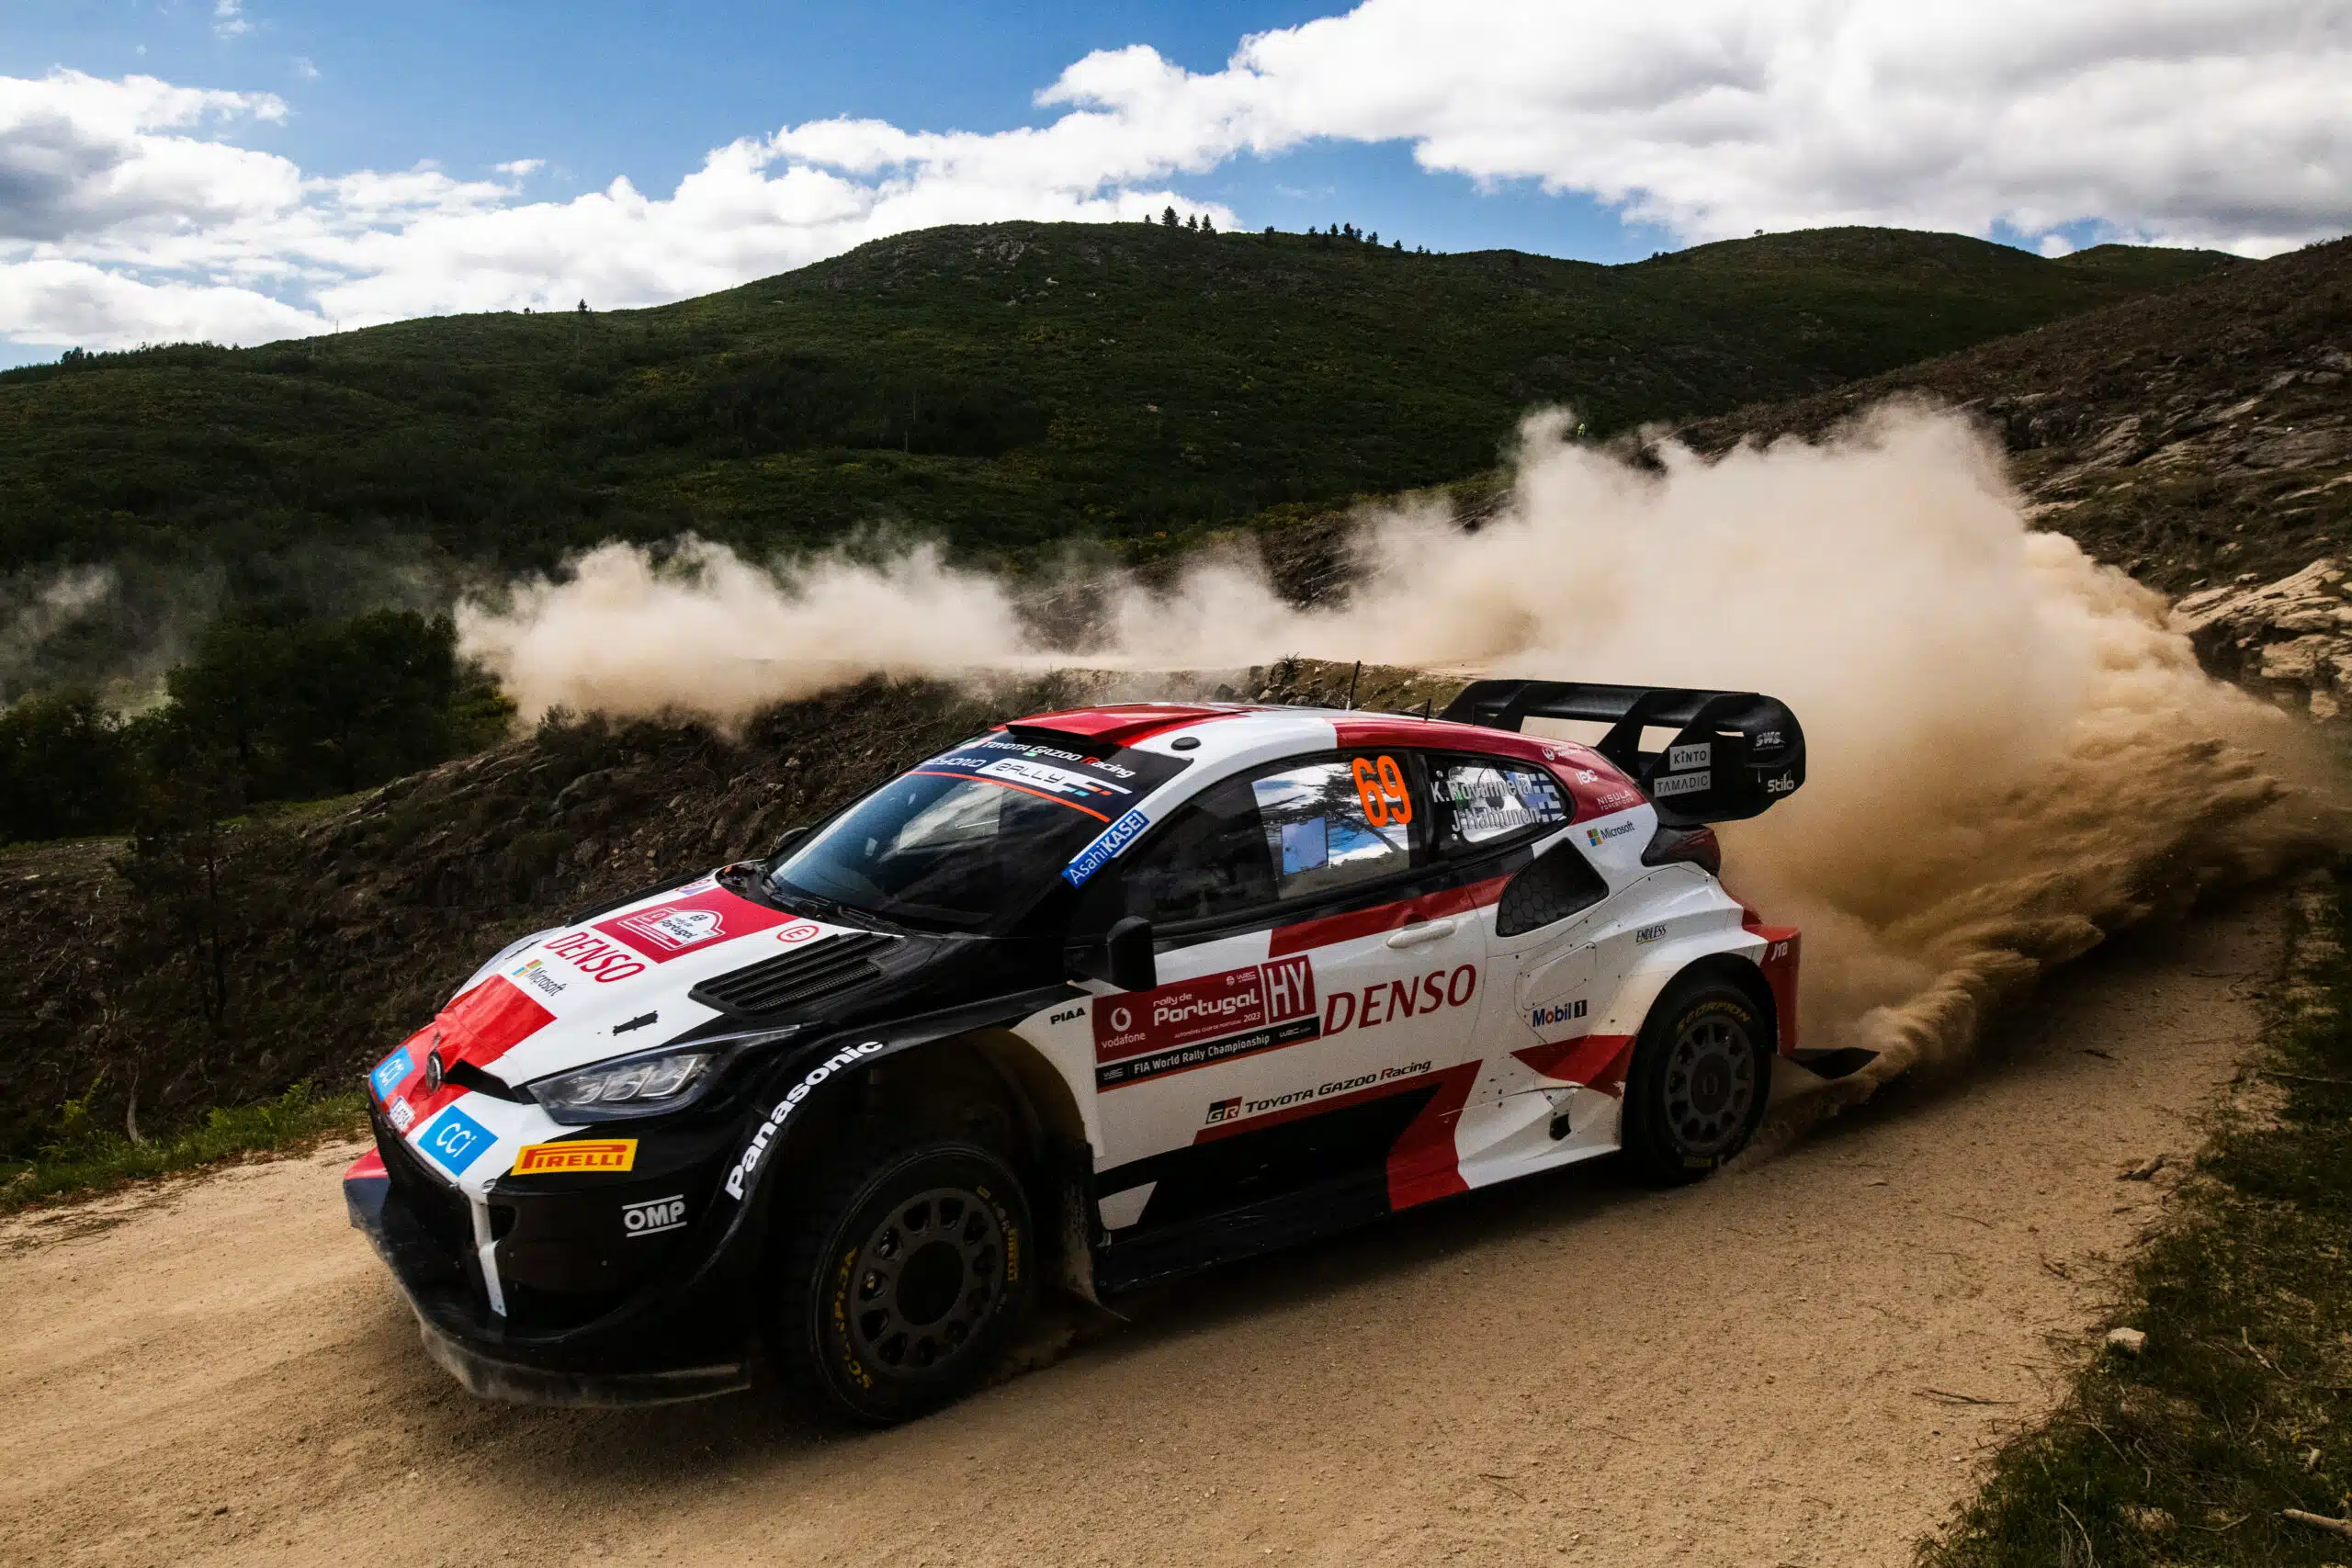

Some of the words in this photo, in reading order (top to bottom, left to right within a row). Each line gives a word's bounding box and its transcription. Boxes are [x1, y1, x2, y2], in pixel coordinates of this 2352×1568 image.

[981, 740, 1033, 753] TOYOTA
[1033, 745, 1083, 761] GAZOO
[1080, 756, 1136, 780] Racing
[1351, 755, 1413, 828] 69
[1657, 775, 1709, 794] TAMADIC
[1767, 773, 1795, 794] Stilo
[1597, 790, 1633, 806] NISULA
[1600, 820, 1635, 840] Microsoft
[1069, 812, 1146, 885] AsahiKASEI
[1635, 923, 1667, 942] ENDLESS
[543, 931, 646, 984] DENSO
[1770, 942, 1789, 962] JTB
[526, 966, 569, 997] Microsoft
[1266, 962, 1306, 1018] HY
[1153, 996, 1178, 1008] rally
[1179, 993, 1193, 1001] de
[1154, 988, 1260, 1027] Portugal
[1322, 964, 1476, 1038] DENSO
[1050, 1007, 1086, 1025] PIAA
[1243, 1011, 1261, 1023] 2023
[1532, 1003, 1572, 1028] Mobil
[1102, 1032, 1146, 1049] vodafone
[1134, 1063, 1150, 1075] FIA
[1152, 1054, 1180, 1070] World
[1182, 1049, 1205, 1065] Rally
[1208, 1034, 1271, 1056] Championship
[1205, 1105, 1239, 1123] GR
[1245, 1089, 1314, 1113] TOYOTA
[1317, 1072, 1377, 1097] GAZOO
[1379, 1060, 1432, 1082] Racing
[725, 1041, 884, 1201] Panasonic
[521, 1145, 628, 1169] PIRELLI
[624, 1201, 686, 1231] OMP
